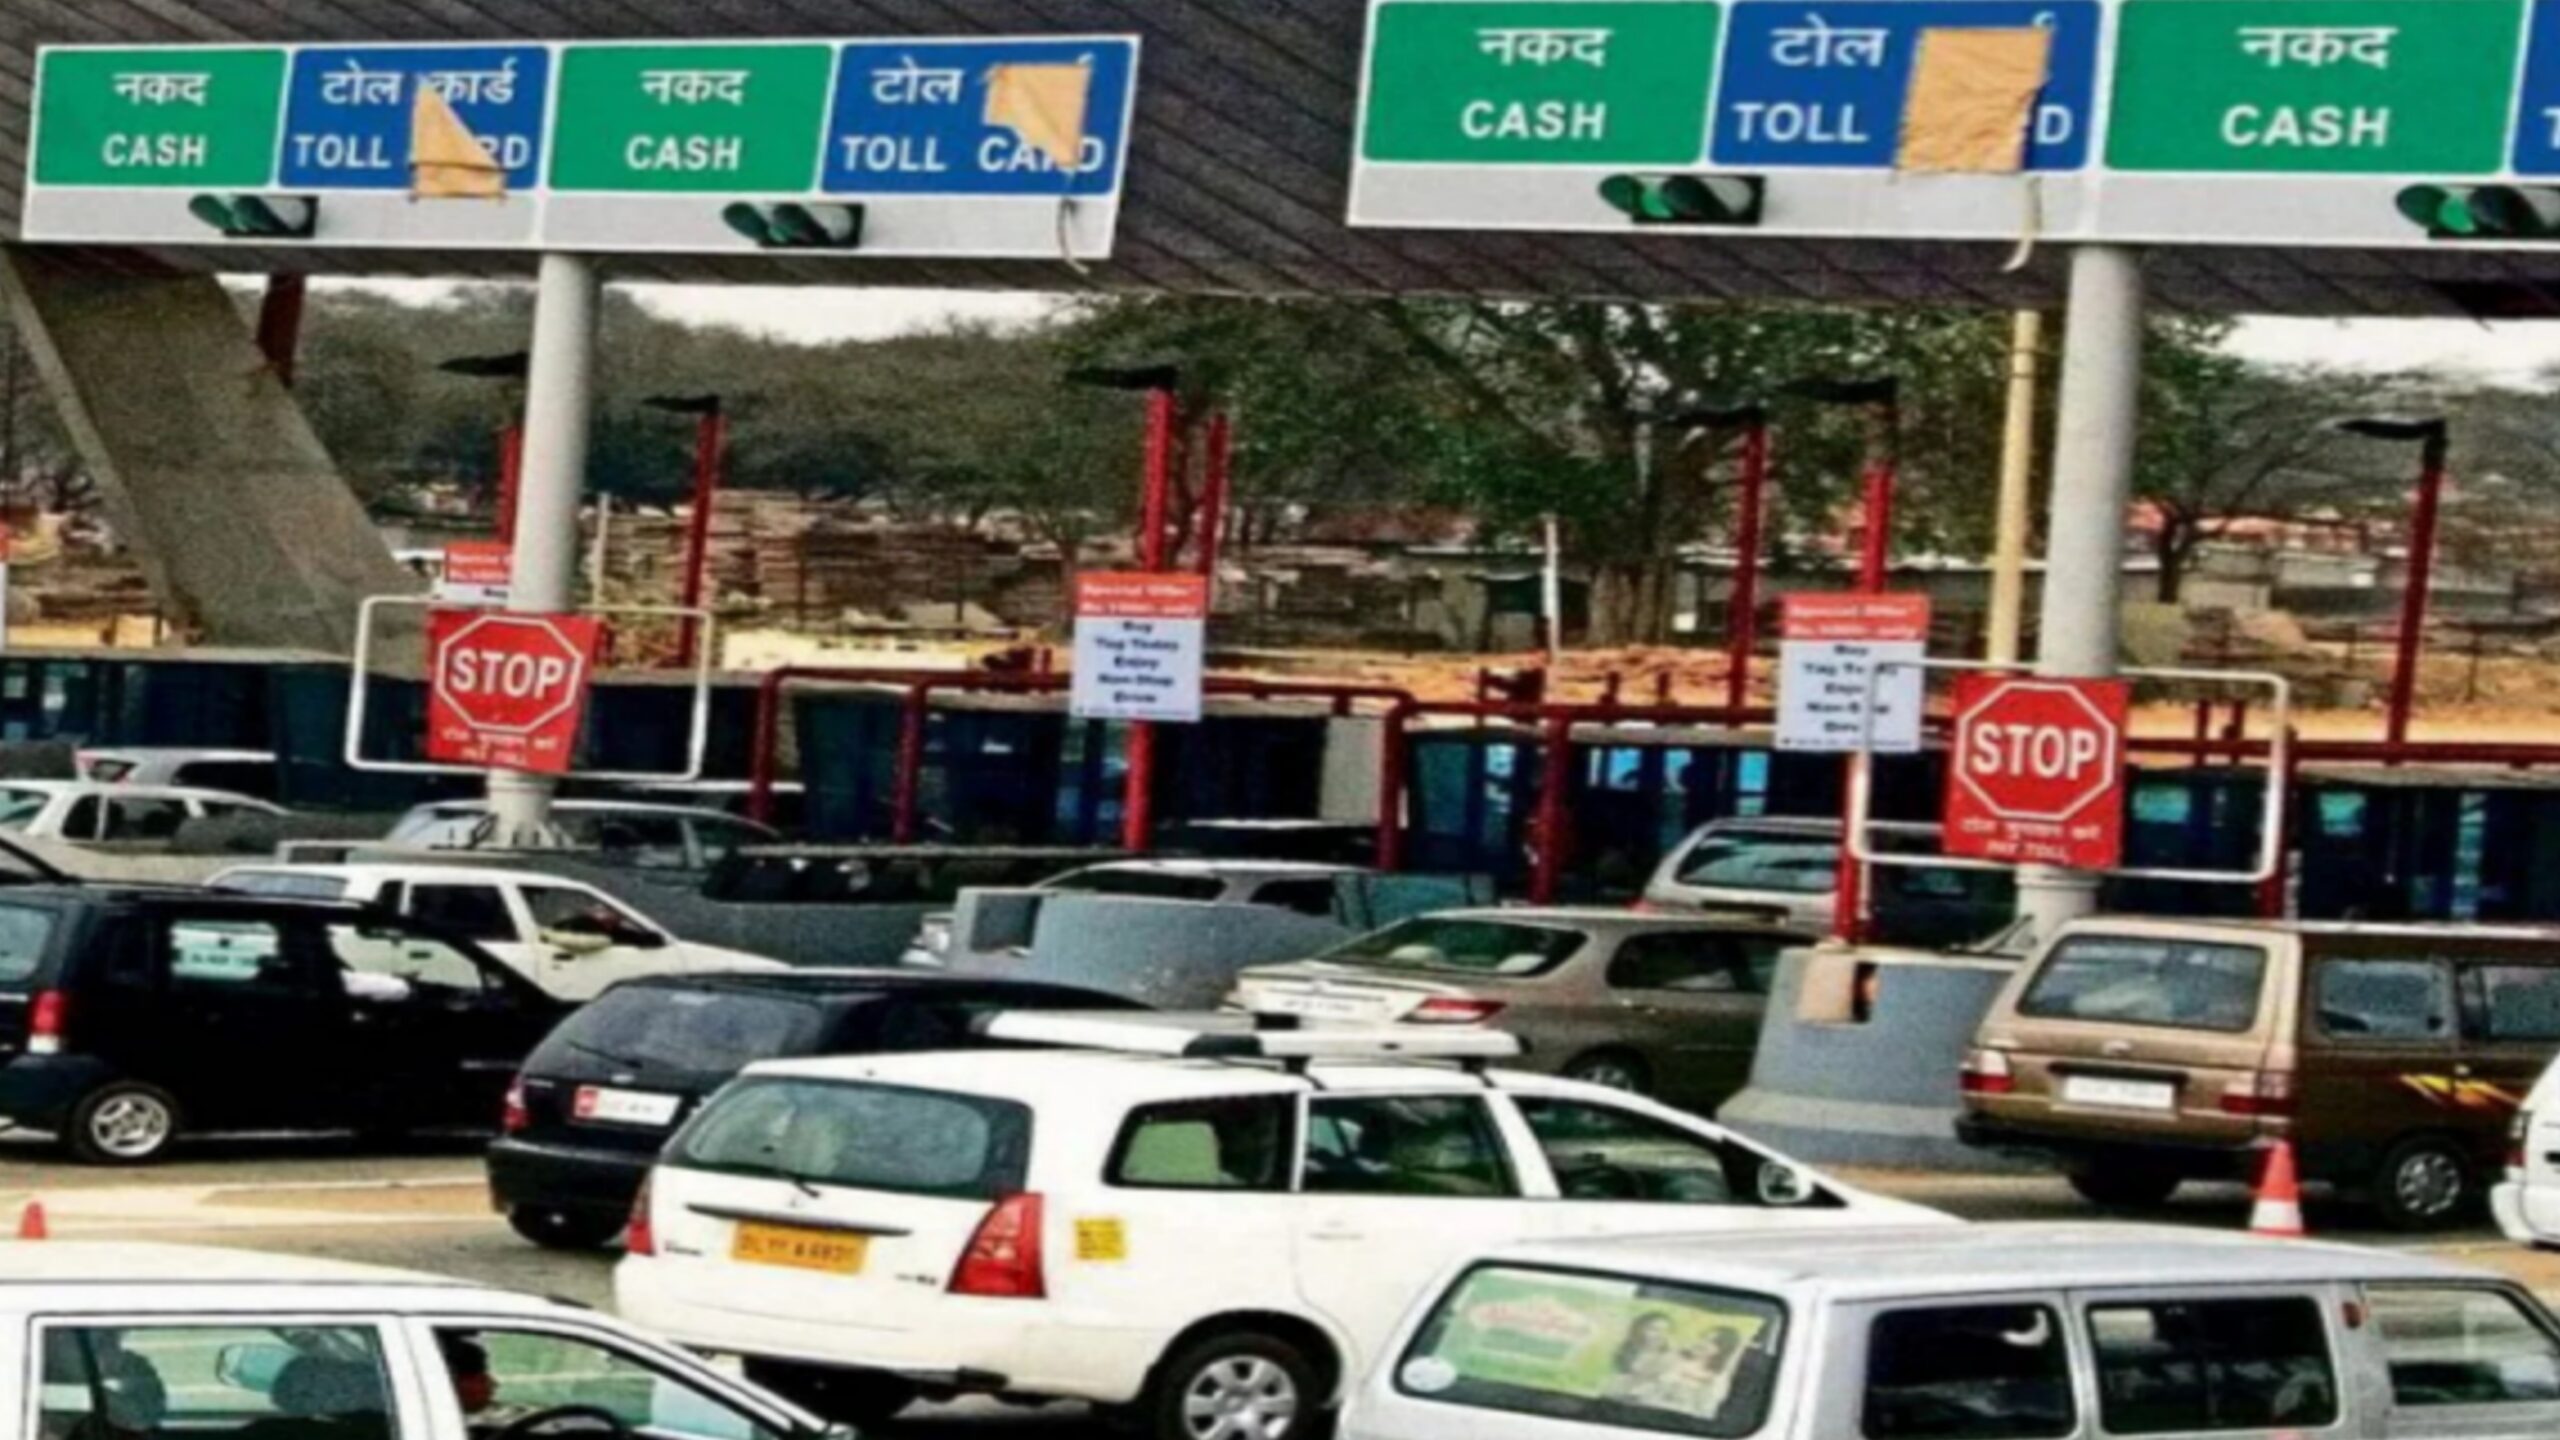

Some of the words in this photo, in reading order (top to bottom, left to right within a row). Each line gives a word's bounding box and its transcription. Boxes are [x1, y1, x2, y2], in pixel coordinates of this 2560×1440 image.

[1477, 27, 1612, 66] नकद
[1772, 14, 1888, 66] टोल
[2239, 26, 2398, 67] नकद
[113, 72, 210, 104] नकद
[323, 60, 403, 104] टोल
[640, 68, 749, 103] नकद
[873, 57, 964, 103] टोल
[1461, 101, 1606, 140] CASH
[1734, 102, 1868, 142] TOLL
[2221, 105, 2389, 146] CASH
[102, 134, 206, 166] CASH
[294, 134, 391, 168] TOLL
[625, 135, 741, 170] CASH
[842, 136, 946, 171] TOLL
[450, 648, 565, 700] STOP
[1970, 721, 2099, 780] STOP
